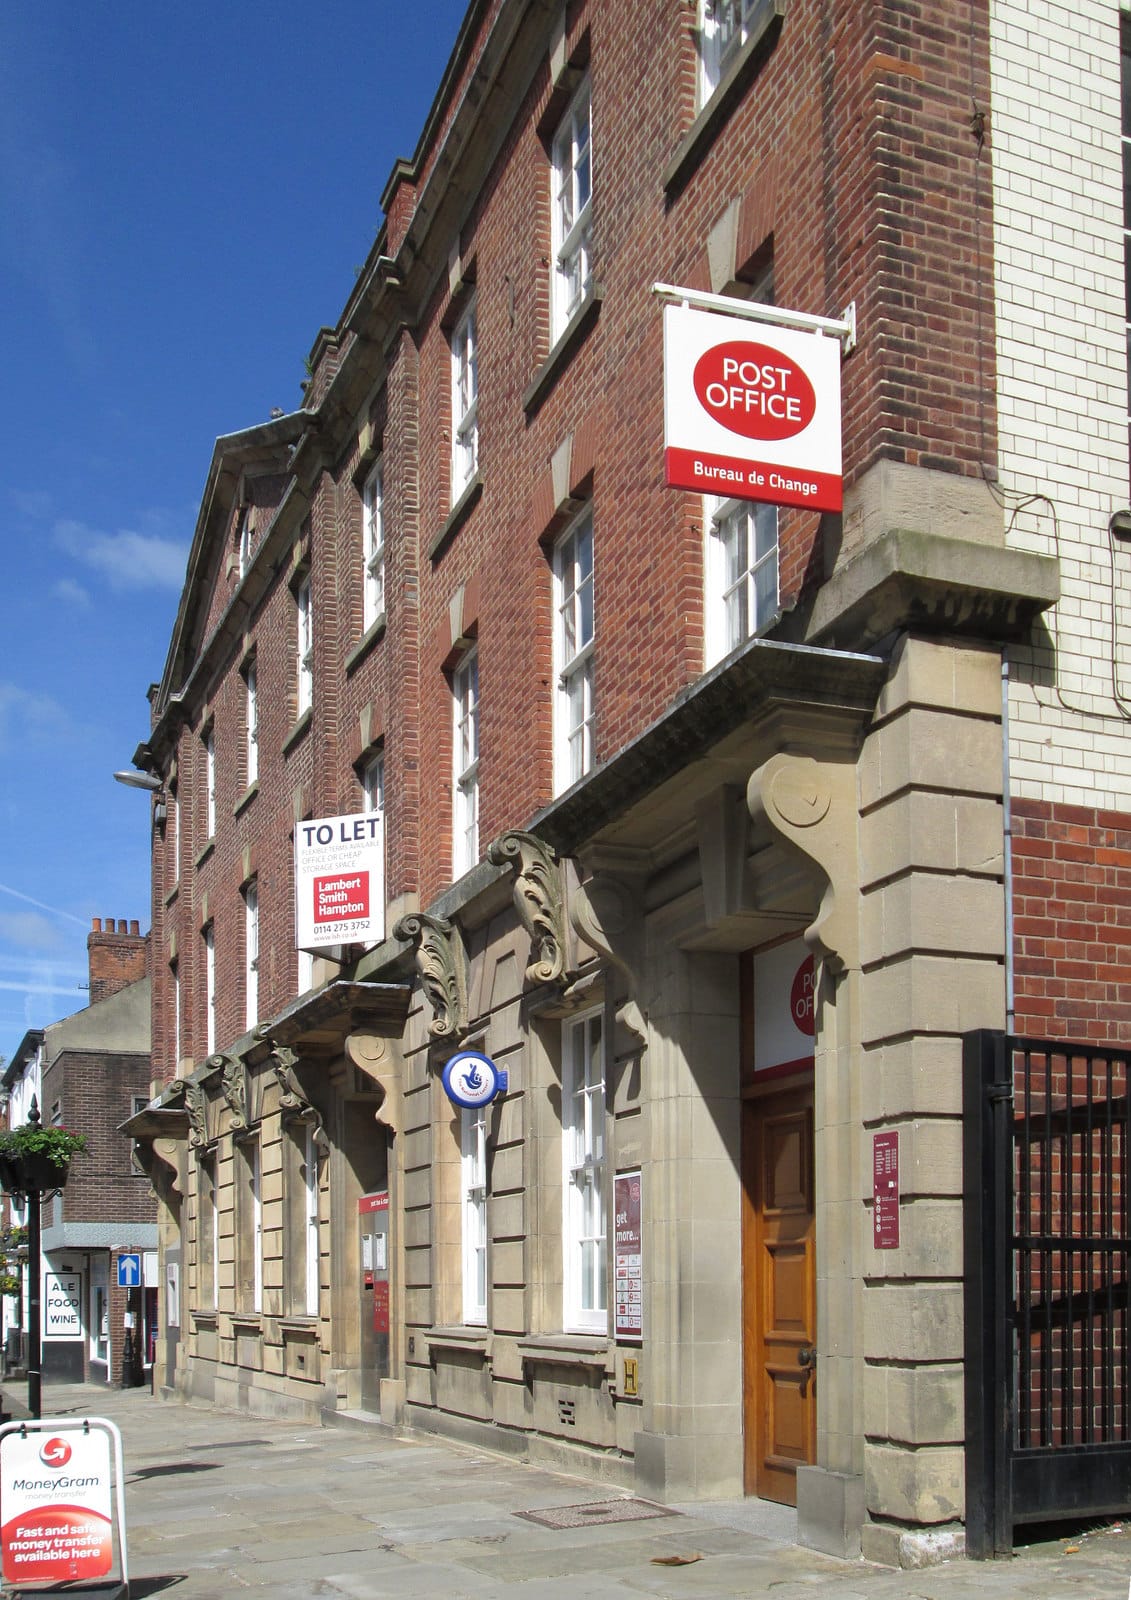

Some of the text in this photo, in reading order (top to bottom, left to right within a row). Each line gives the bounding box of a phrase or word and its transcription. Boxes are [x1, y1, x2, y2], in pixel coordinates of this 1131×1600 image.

[723, 358, 791, 391] POST
[706, 383, 802, 421] OFFICE
[694, 460, 818, 496] Bureau de Change
[302, 818, 380, 847] TO LET
[302, 854, 326, 865] OFFICE
[327, 853, 338, 862] OR
[302, 863, 333, 873] STORAGE
[318, 878, 361, 892] Lambert
[318, 890, 348, 904] Smith
[318, 902, 365, 916] Hampton
[313, 920, 371, 935] 0114 275 3752
[616, 1211, 627, 1228] get
[616, 1230, 639, 1242] more...
[52, 1282, 75, 1292] ALE
[48, 1298, 79, 1308] FOOD
[50, 1314, 77, 1324] WINE
[624, 1360, 637, 1390] H
[13, 1476, 99, 1491] MoneyGram
[25, 1490, 87, 1501] money transfer
[16, 1521, 97, 1539] Fast and safe
[9, 1534, 105, 1553] money transfer
[14, 1547, 100, 1563] available here
